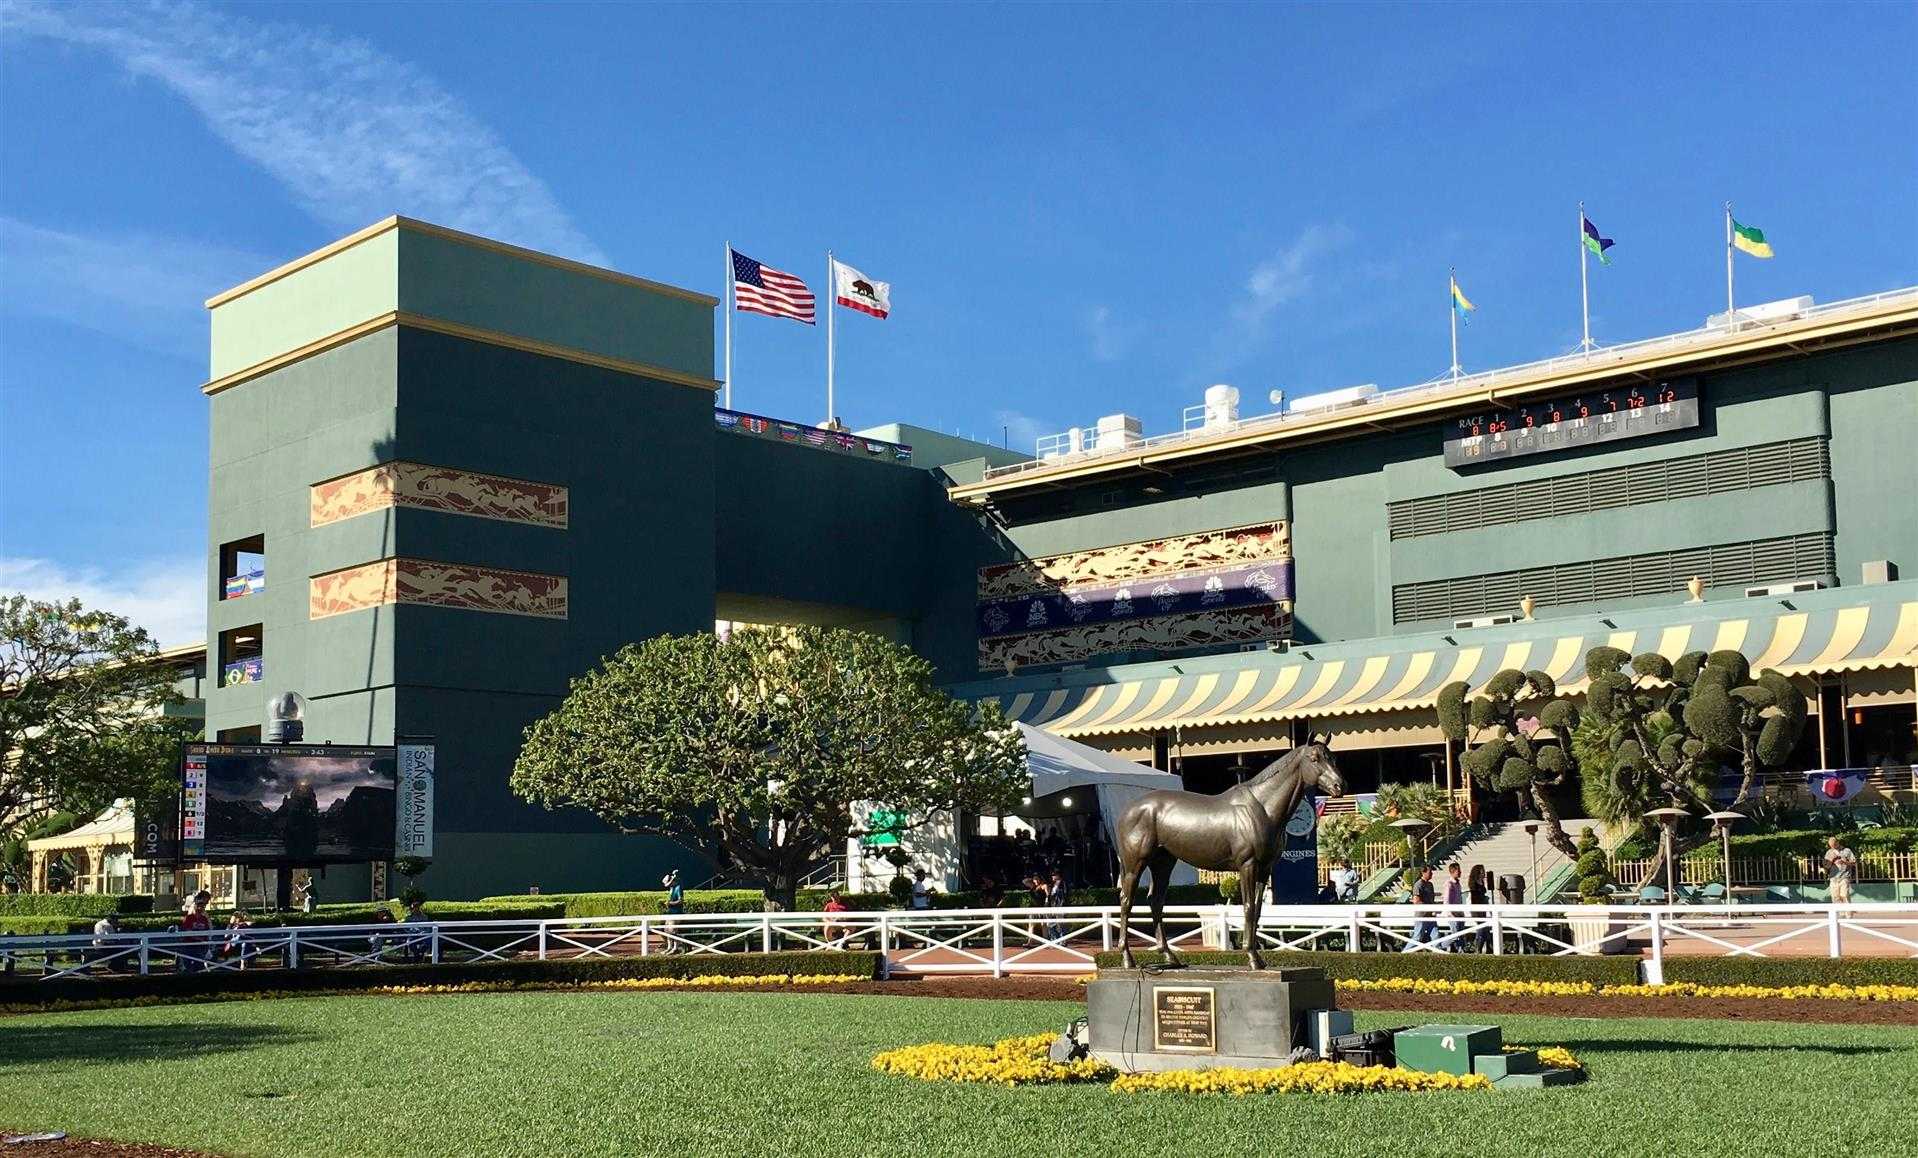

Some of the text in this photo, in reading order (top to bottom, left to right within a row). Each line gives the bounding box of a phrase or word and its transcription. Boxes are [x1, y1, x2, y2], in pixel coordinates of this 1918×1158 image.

[1459, 415, 1484, 429] RACE
[1520, 408, 1528, 418] 2
[1603, 393, 1609, 404] 5
[1631, 388, 1638, 398] 6
[1661, 383, 1670, 392] 7
[1472, 425, 1479, 436] 8
[1526, 416, 1533, 427] 9
[1580, 406, 1588, 417] 9
[1610, 401, 1616, 411] 7
[1461, 435, 1482, 447] MTP
[1520, 427, 1528, 438] 9
[1547, 422, 1557, 433] 10
[1601, 412, 1613, 422] 12
[1630, 408, 1642, 418] 13
[405, 750, 413, 779] INDIAN
[412, 750, 427, 851] SAN MANUEL
[1281, 850, 1316, 858] NGINES
